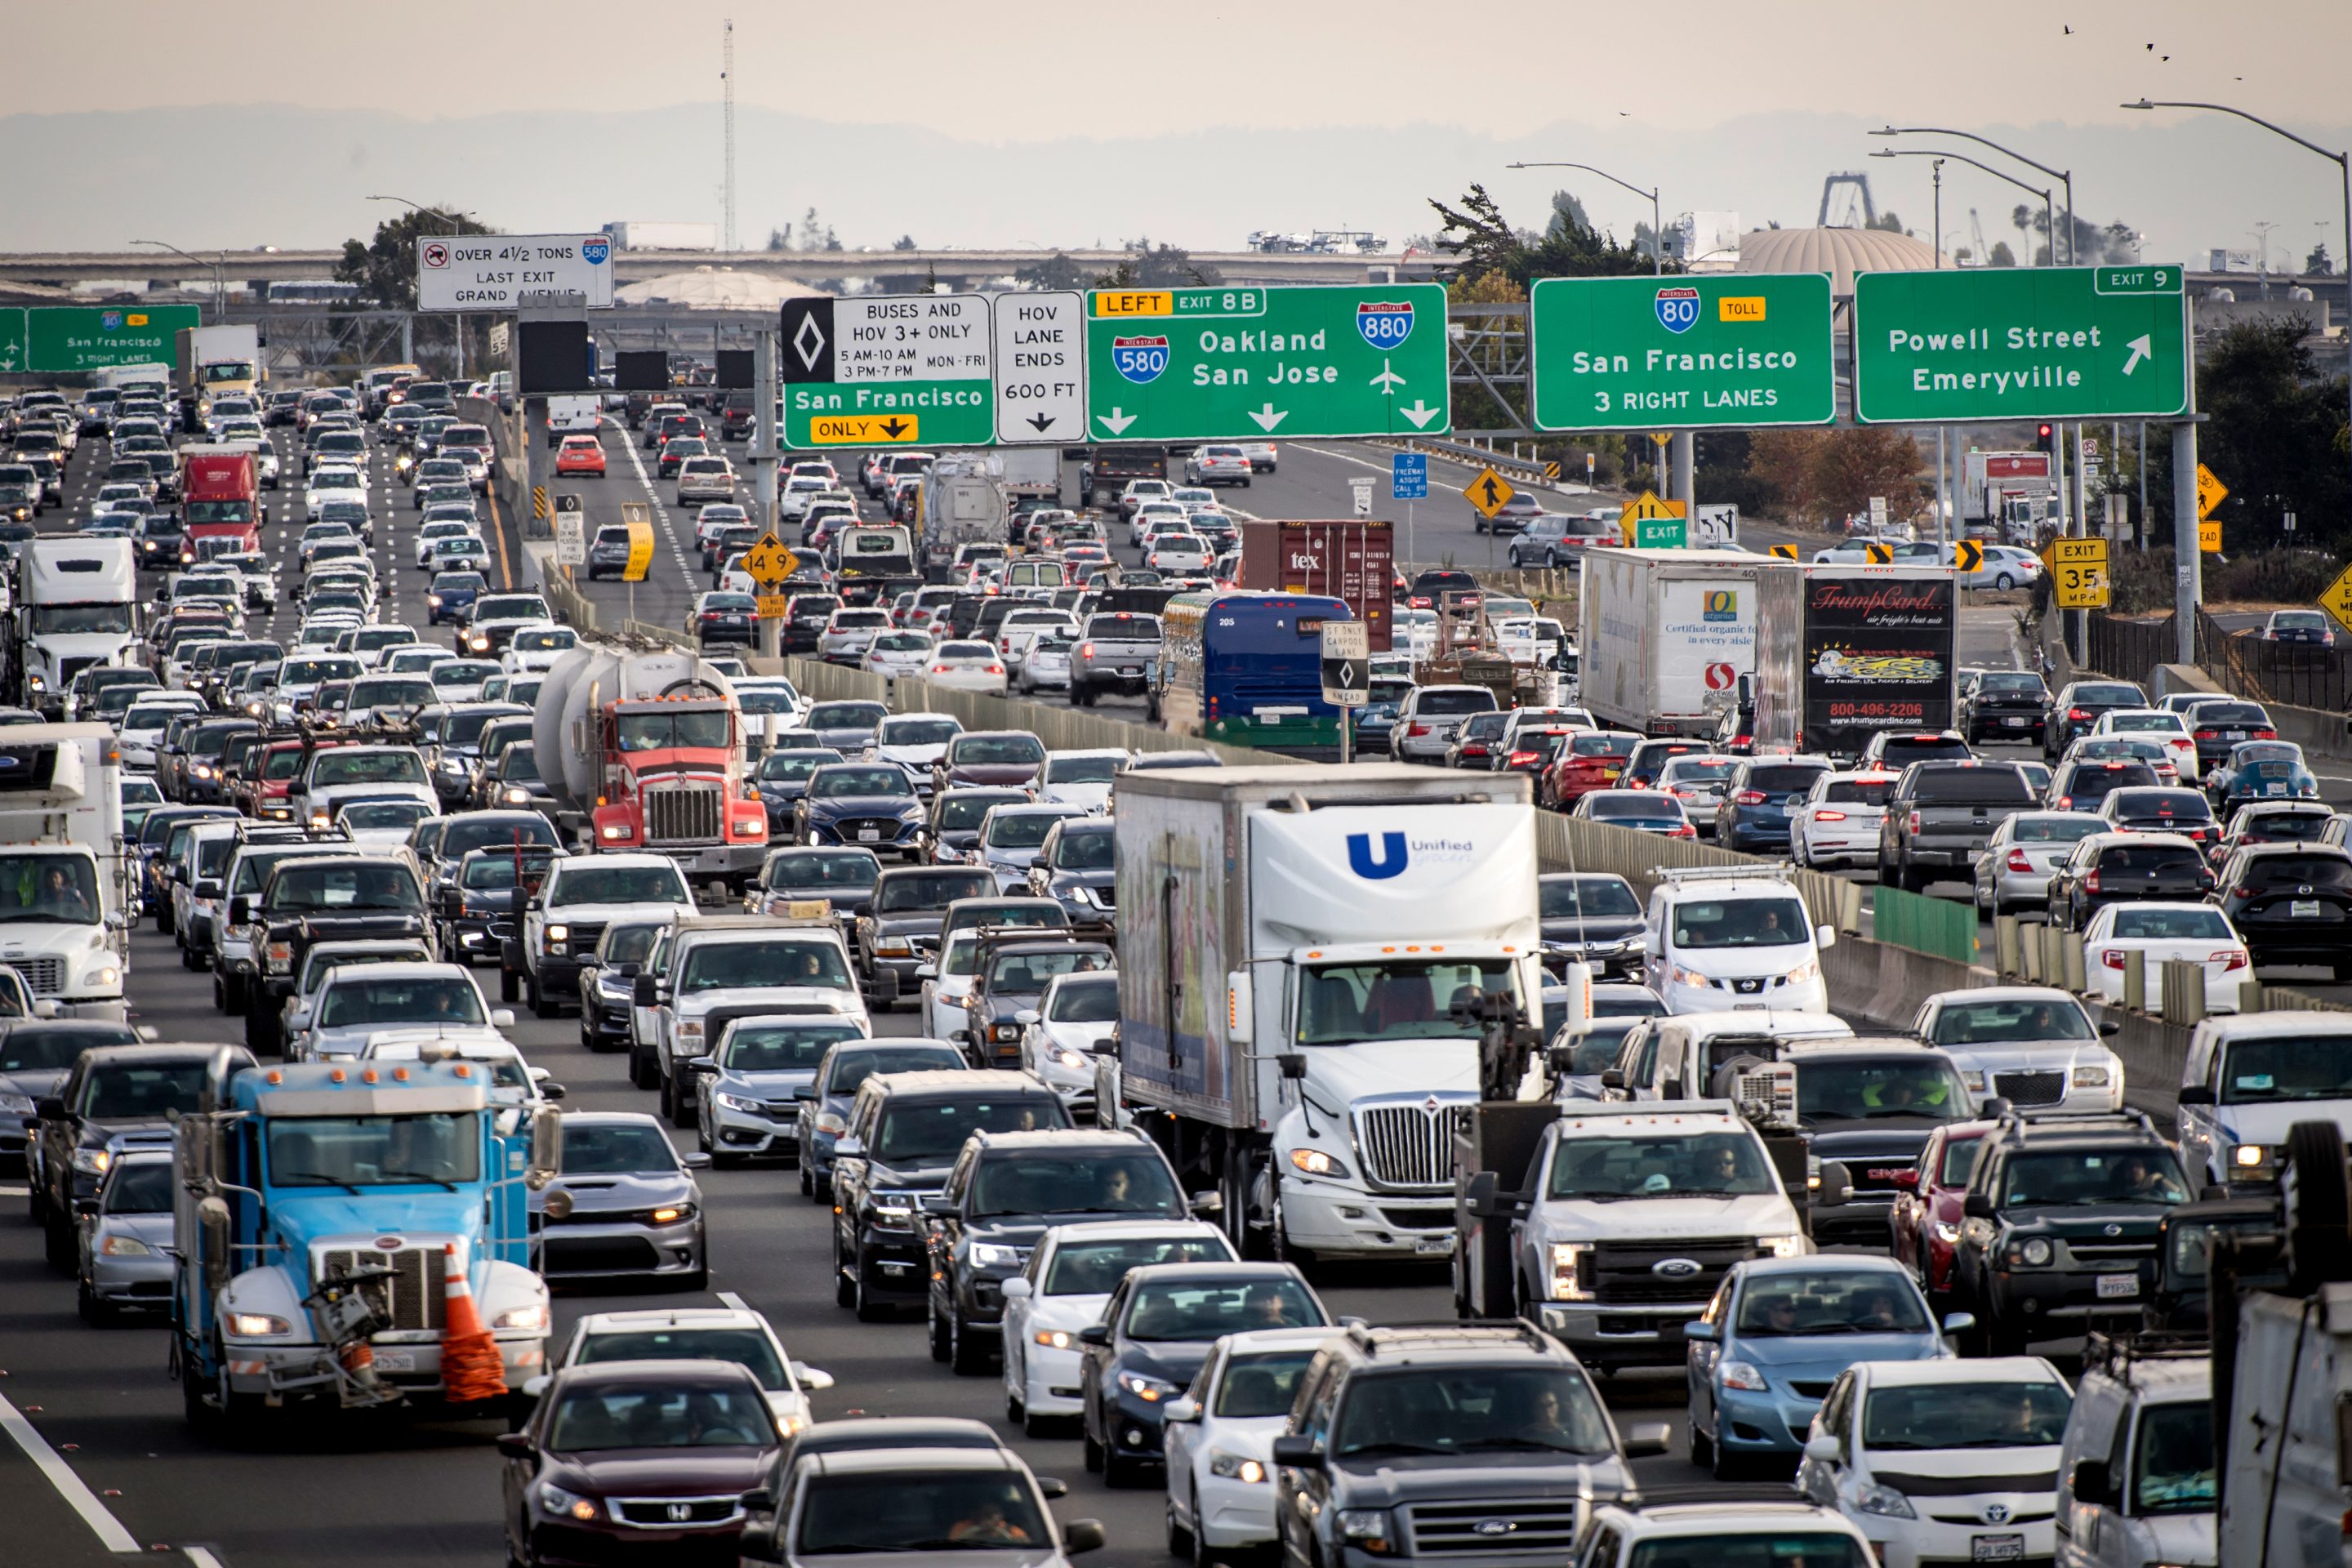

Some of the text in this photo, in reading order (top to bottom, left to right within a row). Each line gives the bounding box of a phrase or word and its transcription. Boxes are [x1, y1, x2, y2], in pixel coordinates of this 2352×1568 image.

[456, 249, 492, 261] OVER
[537, 247, 573, 259] TONS
[585, 247, 607, 258] 580
[476, 271, 555, 283] LAST EXIT
[2112, 270, 2167, 287] EXIT 9
[456, 290, 507, 301] GRAND
[867, 303, 961, 319] BUSES AND
[1107, 296, 1161, 312] LEFT
[1179, 296, 1213, 309] EXIT
[1726, 303, 1757, 315] TOLL
[1018, 306, 1058, 321] HOV
[1662, 301, 1694, 323] 80
[853, 327, 885, 341] HOV
[929, 324, 972, 340] ONLY
[1365, 317, 1406, 338] 880
[67, 337, 162, 347] San Francisco
[1015, 329, 1064, 344] LANE
[1199, 328, 1326, 353] Oakland
[1890, 325, 2101, 352] Powell Street
[492, 339, 506, 354] 55
[87, 354, 115, 363] RIGHT
[120, 354, 152, 363] LANES
[841, 350, 849, 361] 5
[898, 349, 916, 360] AM
[1015, 353, 1064, 368] ENDS
[1122, 351, 1164, 372] 580
[1572, 347, 1797, 373] San Francisco
[844, 366, 852, 377] 3
[895, 364, 912, 376] PM
[1192, 362, 1339, 385] San Jose
[1913, 365, 2082, 394] Emeryville
[1005, 383, 1076, 399] 600 FT
[795, 387, 982, 410] San Francisco
[1594, 389, 1778, 412] 3 RIGHT LANES
[818, 421, 870, 437] ONLY
[1395, 484, 1411, 492] CALL
[1646, 526, 1678, 539] EXIT
[2199, 532, 2216, 542] EAD
[2064, 545, 2096, 557] EXIT
[1291, 551, 1321, 569] tex
[2065, 568, 2098, 589] 35
[2069, 594, 2096, 603] MPH
[1219, 618, 1235, 626] 205
[1298, 621, 1321, 631] LYN
[1876, 614, 1909, 626] freight's
[1911, 614, 1925, 624] best
[1665, 624, 1757, 635] Certified organic fo
[1688, 635, 1752, 646] in every aisle
[1333, 693, 1361, 702] AHEAD
[1829, 703, 1922, 715] 800-496-2206
[1829, 717, 1922, 725] www.trumpcardinc.com
[1412, 839, 1472, 851] Unified
[1346, 831, 1408, 880] U
